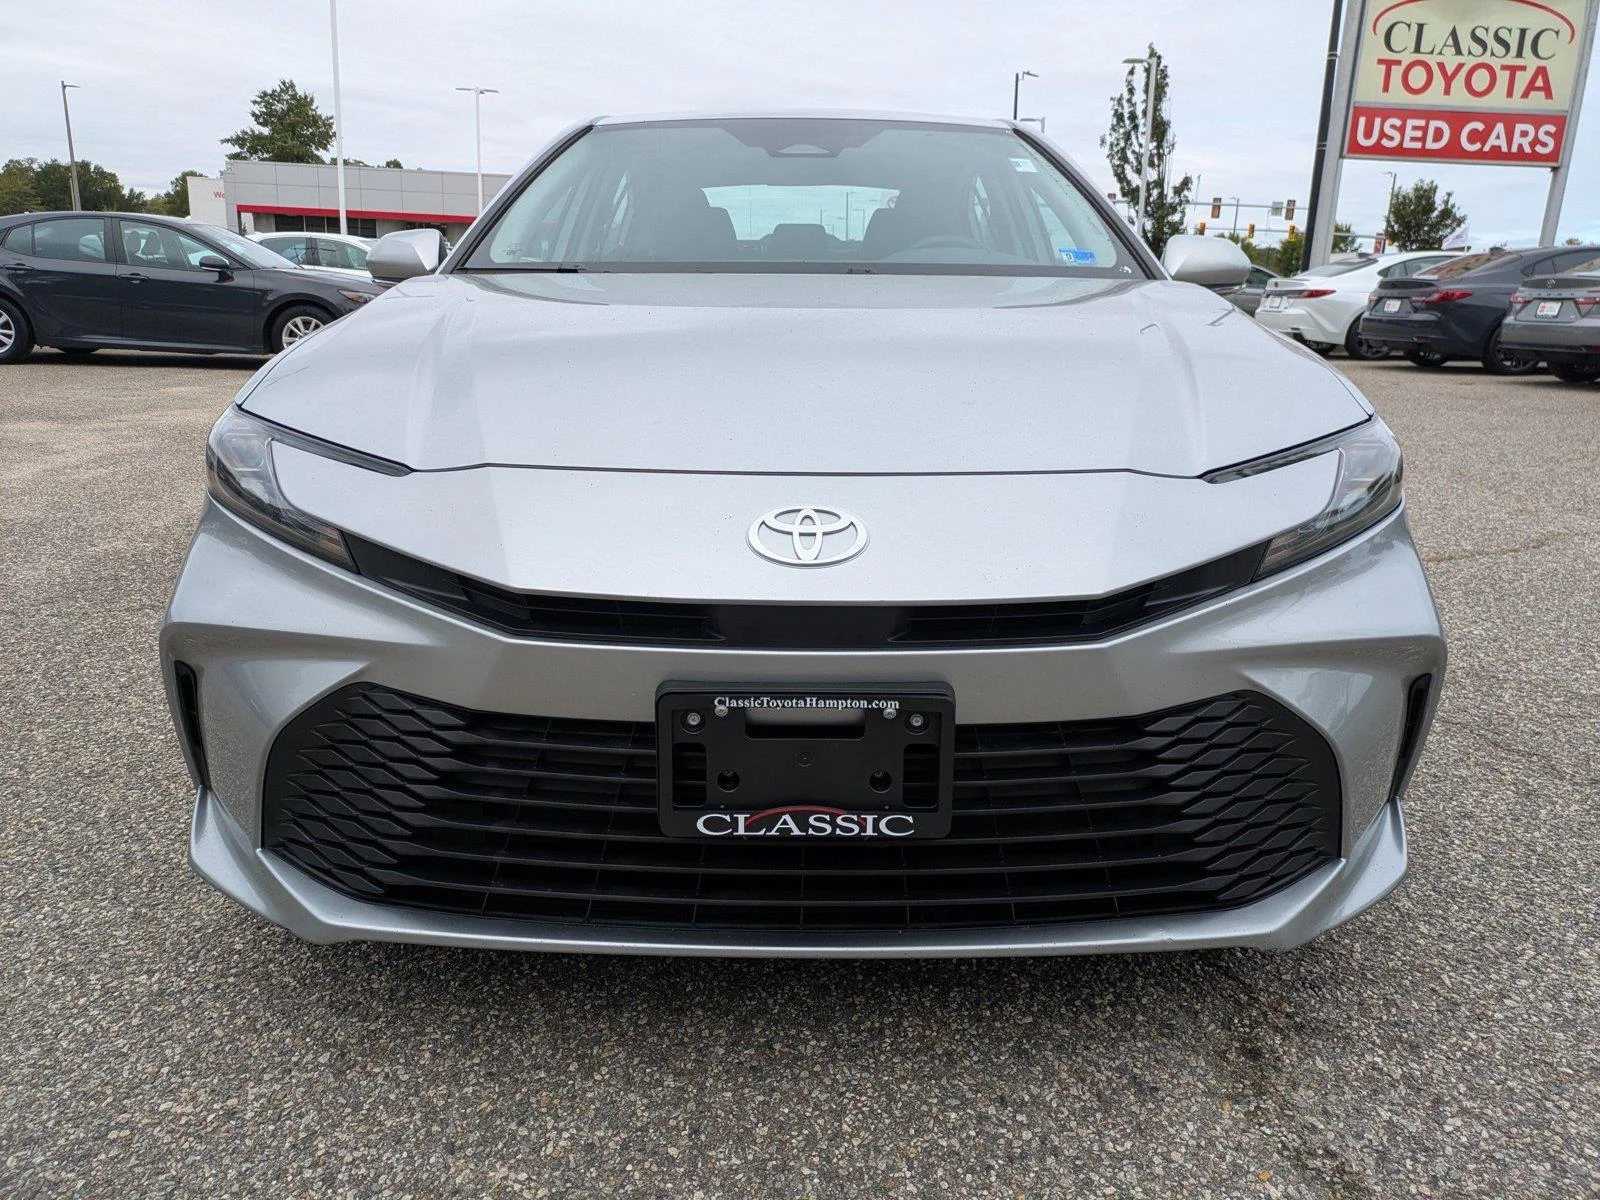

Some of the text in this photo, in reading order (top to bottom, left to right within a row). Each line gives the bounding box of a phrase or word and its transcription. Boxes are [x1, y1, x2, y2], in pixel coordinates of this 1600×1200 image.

[1384, 21, 1561, 60] CLASSIC
[1376, 58, 1554, 100] TOYOTA
[1356, 116, 1557, 154] USED CARS
[714, 697, 900, 710] ClassicToyotaHampton.com
[696, 814, 915, 836] CLASSIC
